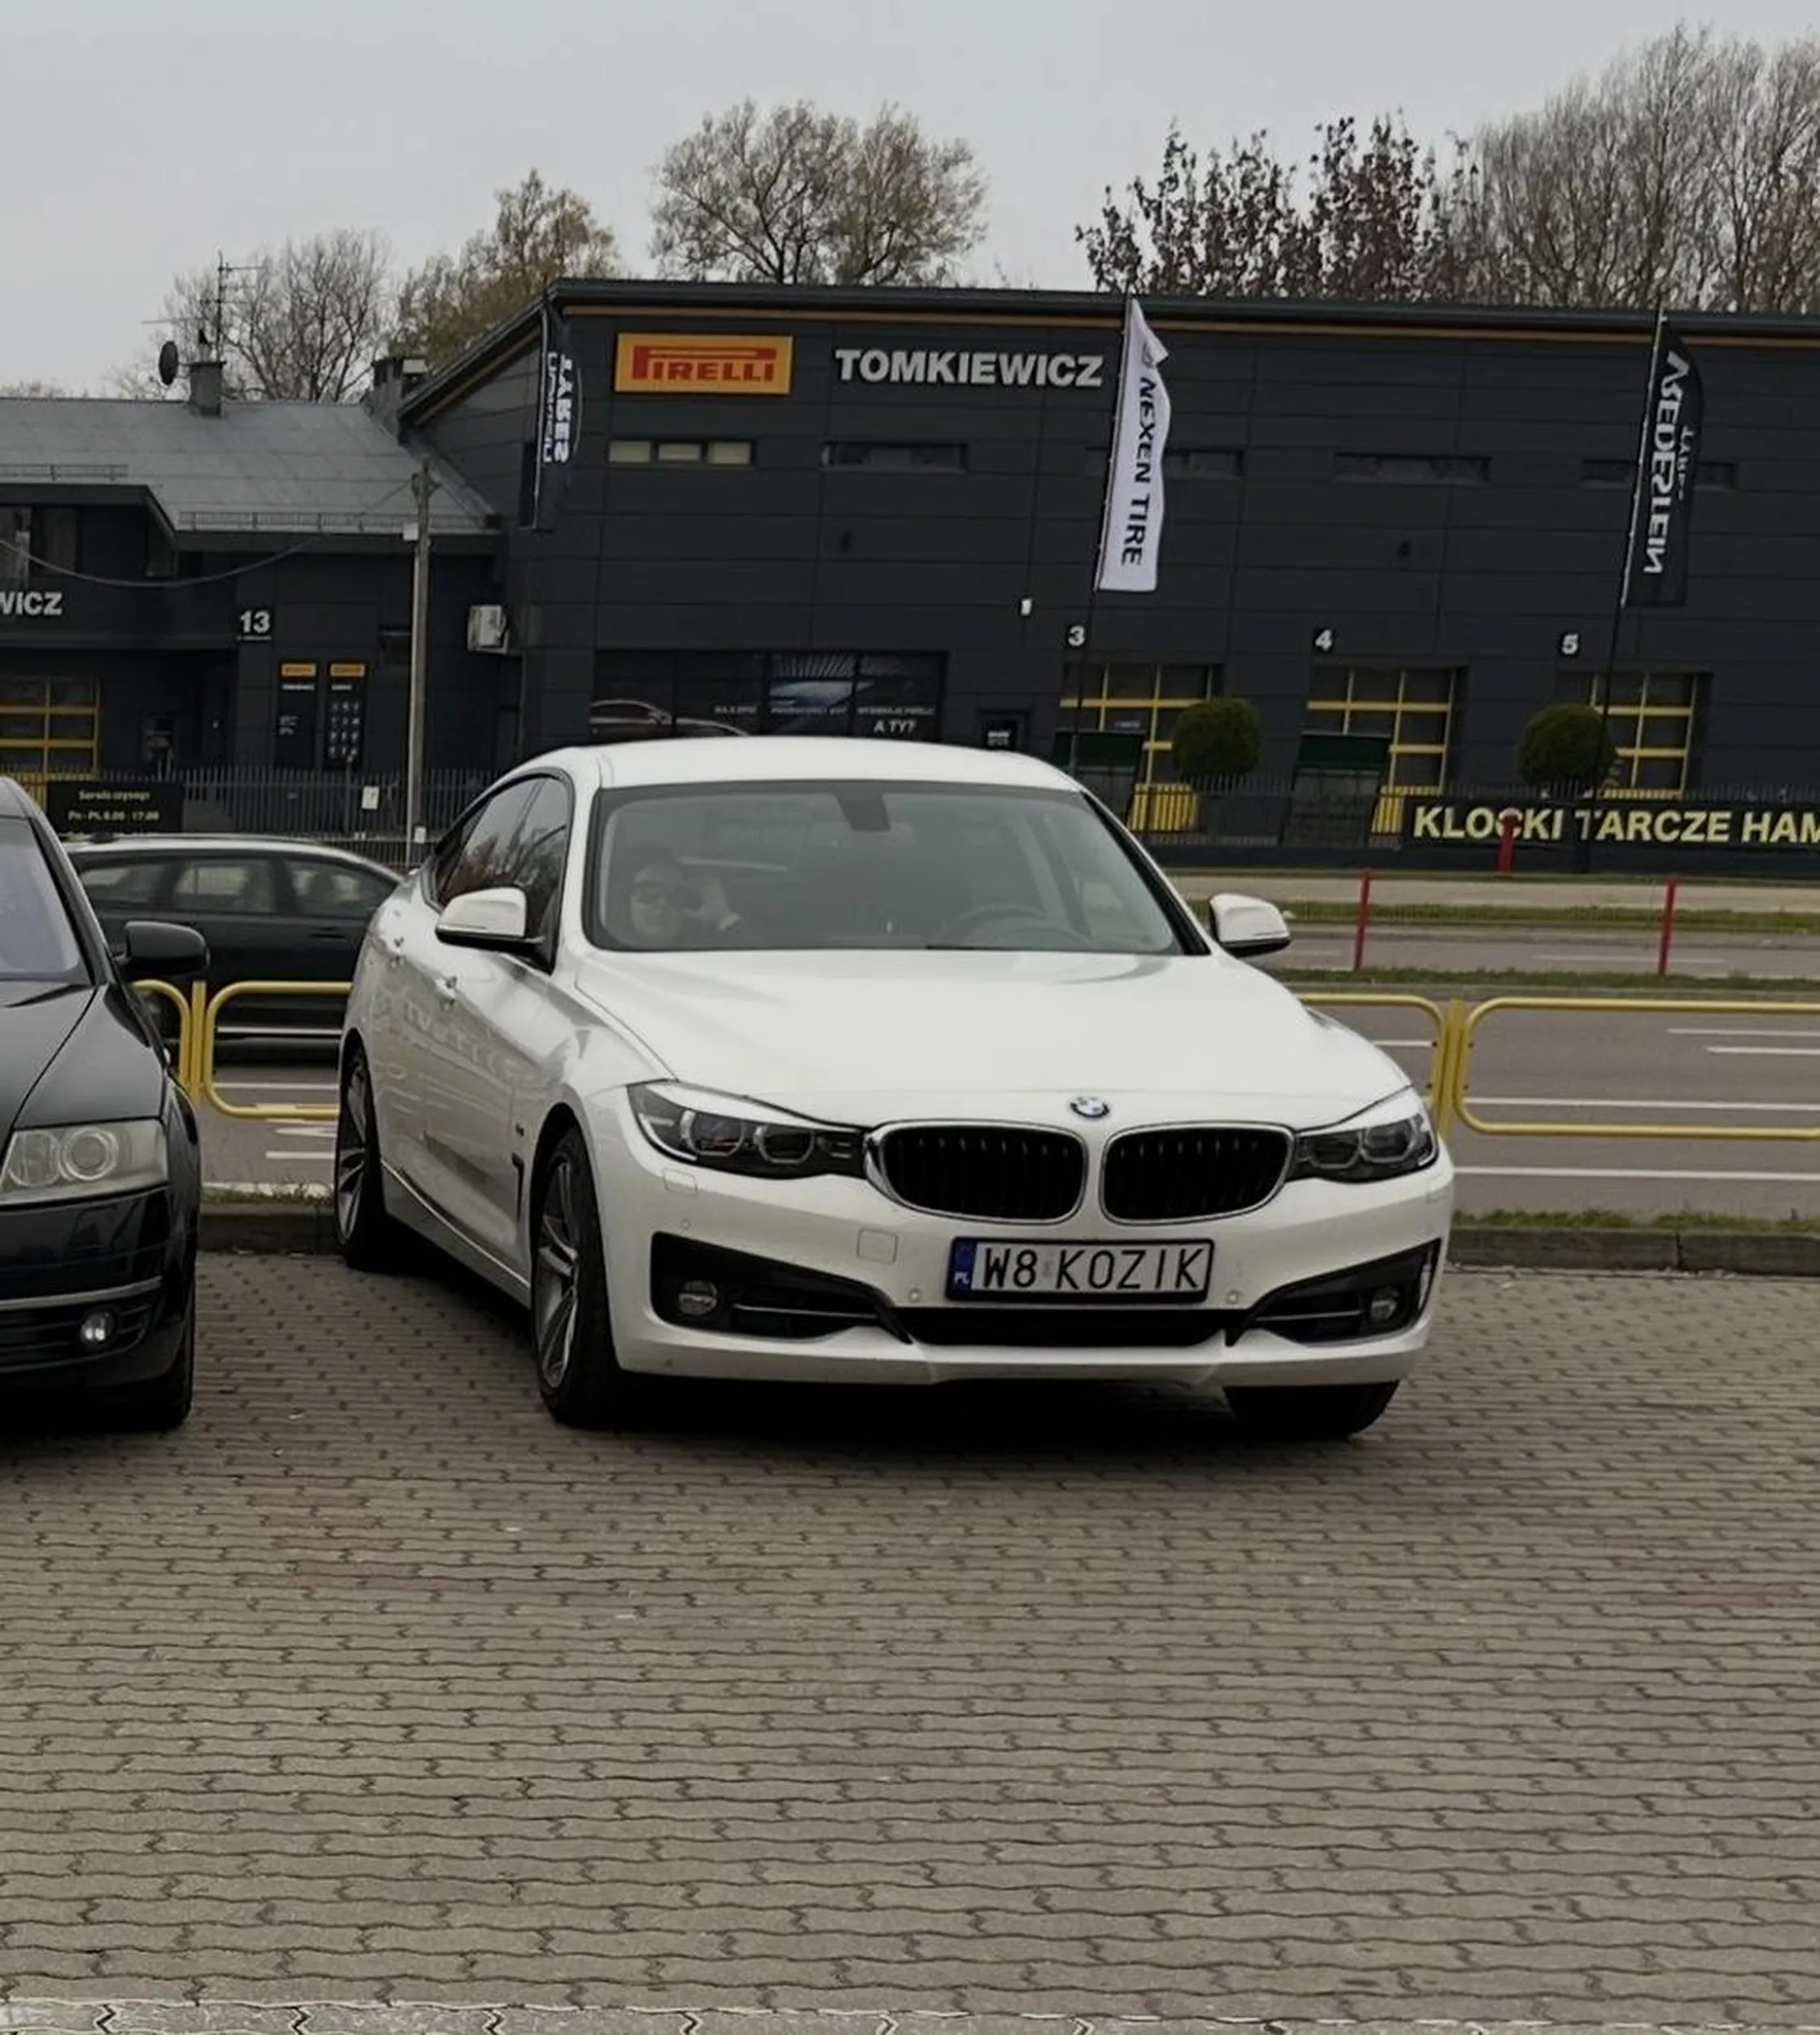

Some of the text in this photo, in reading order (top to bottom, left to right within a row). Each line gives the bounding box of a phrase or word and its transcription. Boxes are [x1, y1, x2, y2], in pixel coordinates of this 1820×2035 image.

[632, 345, 777, 382] PIRELLI
[835, 349, 1103, 387] TOMKIEWICZ
[1122, 376, 1157, 565] NEXEN TIRE
[240, 610, 271, 632] 13
[1068, 625, 1085, 646] 3
[1315, 629, 1332, 650] 4
[1562, 633, 1579, 655] 5
[1414, 806, 1564, 840] KLOCKI
[1574, 808, 1731, 842] TARCZE
[983, 1248, 1204, 1290] W8 KOZIK
